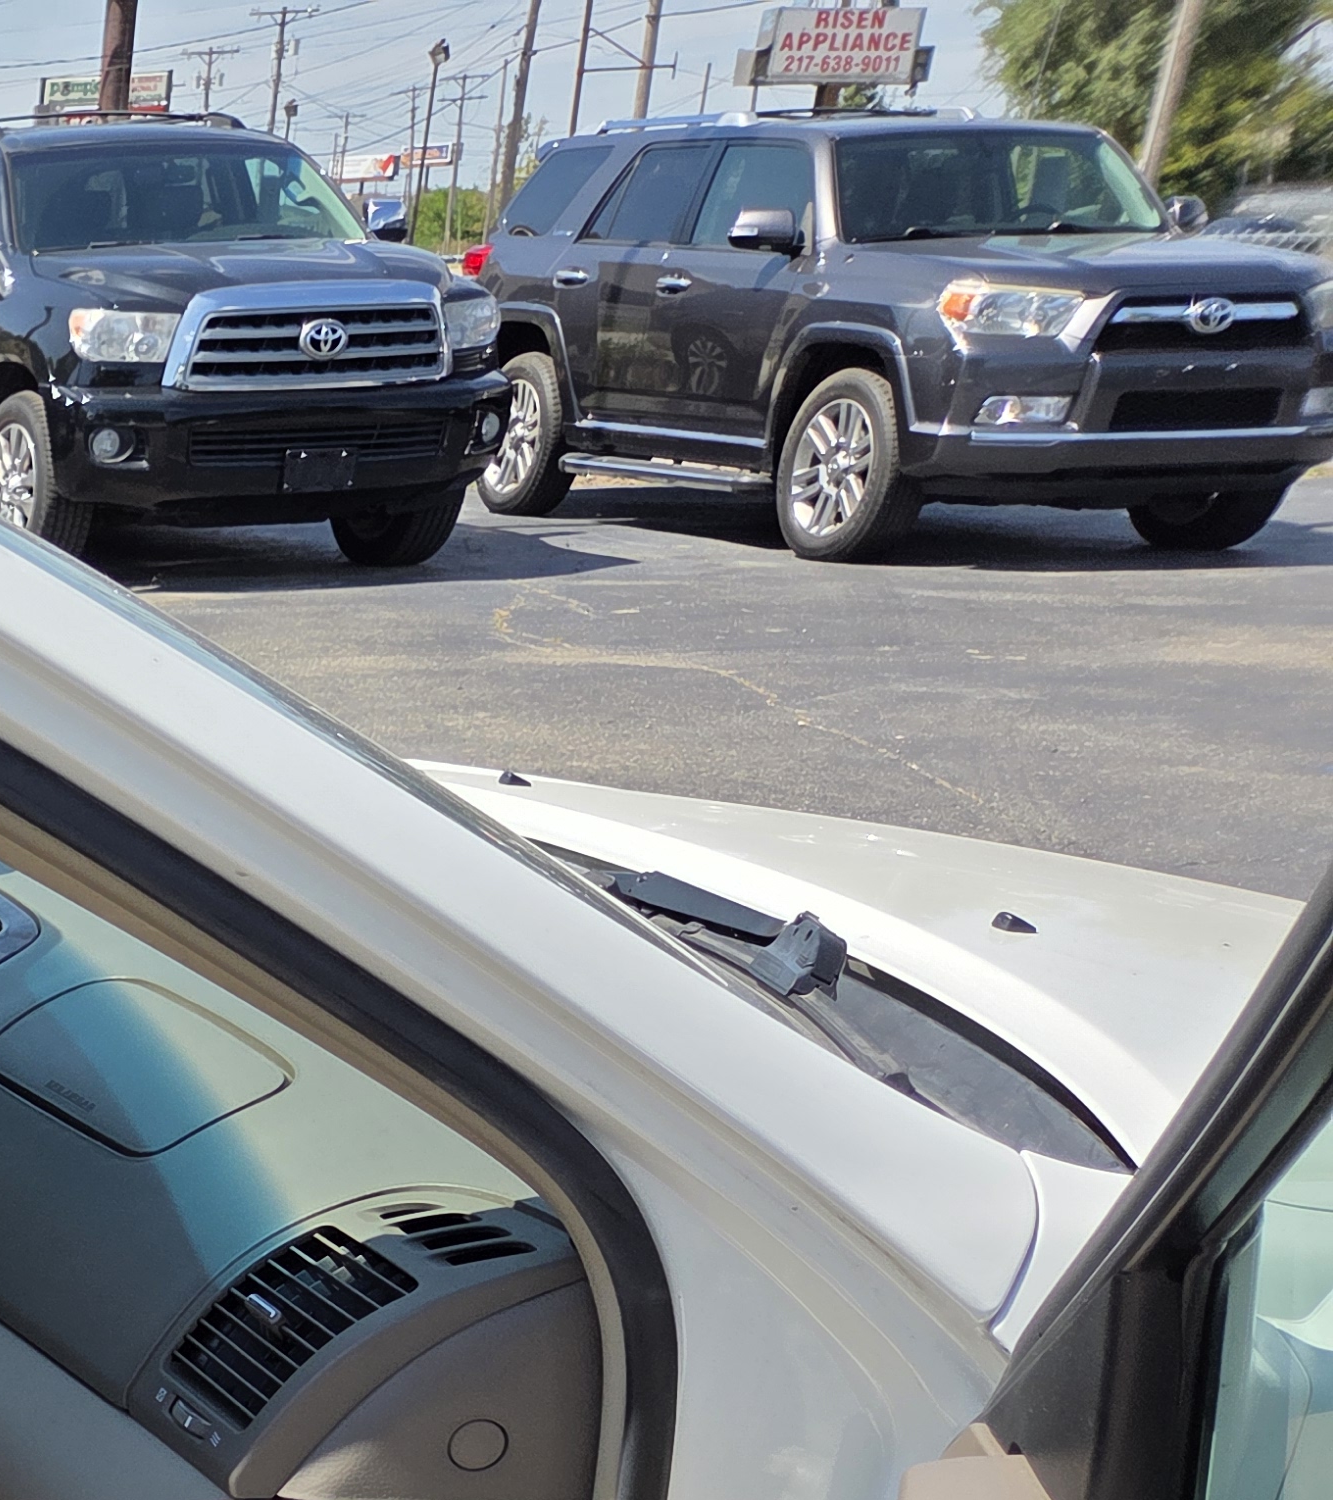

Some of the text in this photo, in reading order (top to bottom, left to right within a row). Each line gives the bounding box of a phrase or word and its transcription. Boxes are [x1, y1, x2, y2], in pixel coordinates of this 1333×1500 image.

[814, 10, 888, 29] RISEN
[780, 32, 913, 52] APPLIANCE
[783, 55, 901, 73] 217-638-9011
